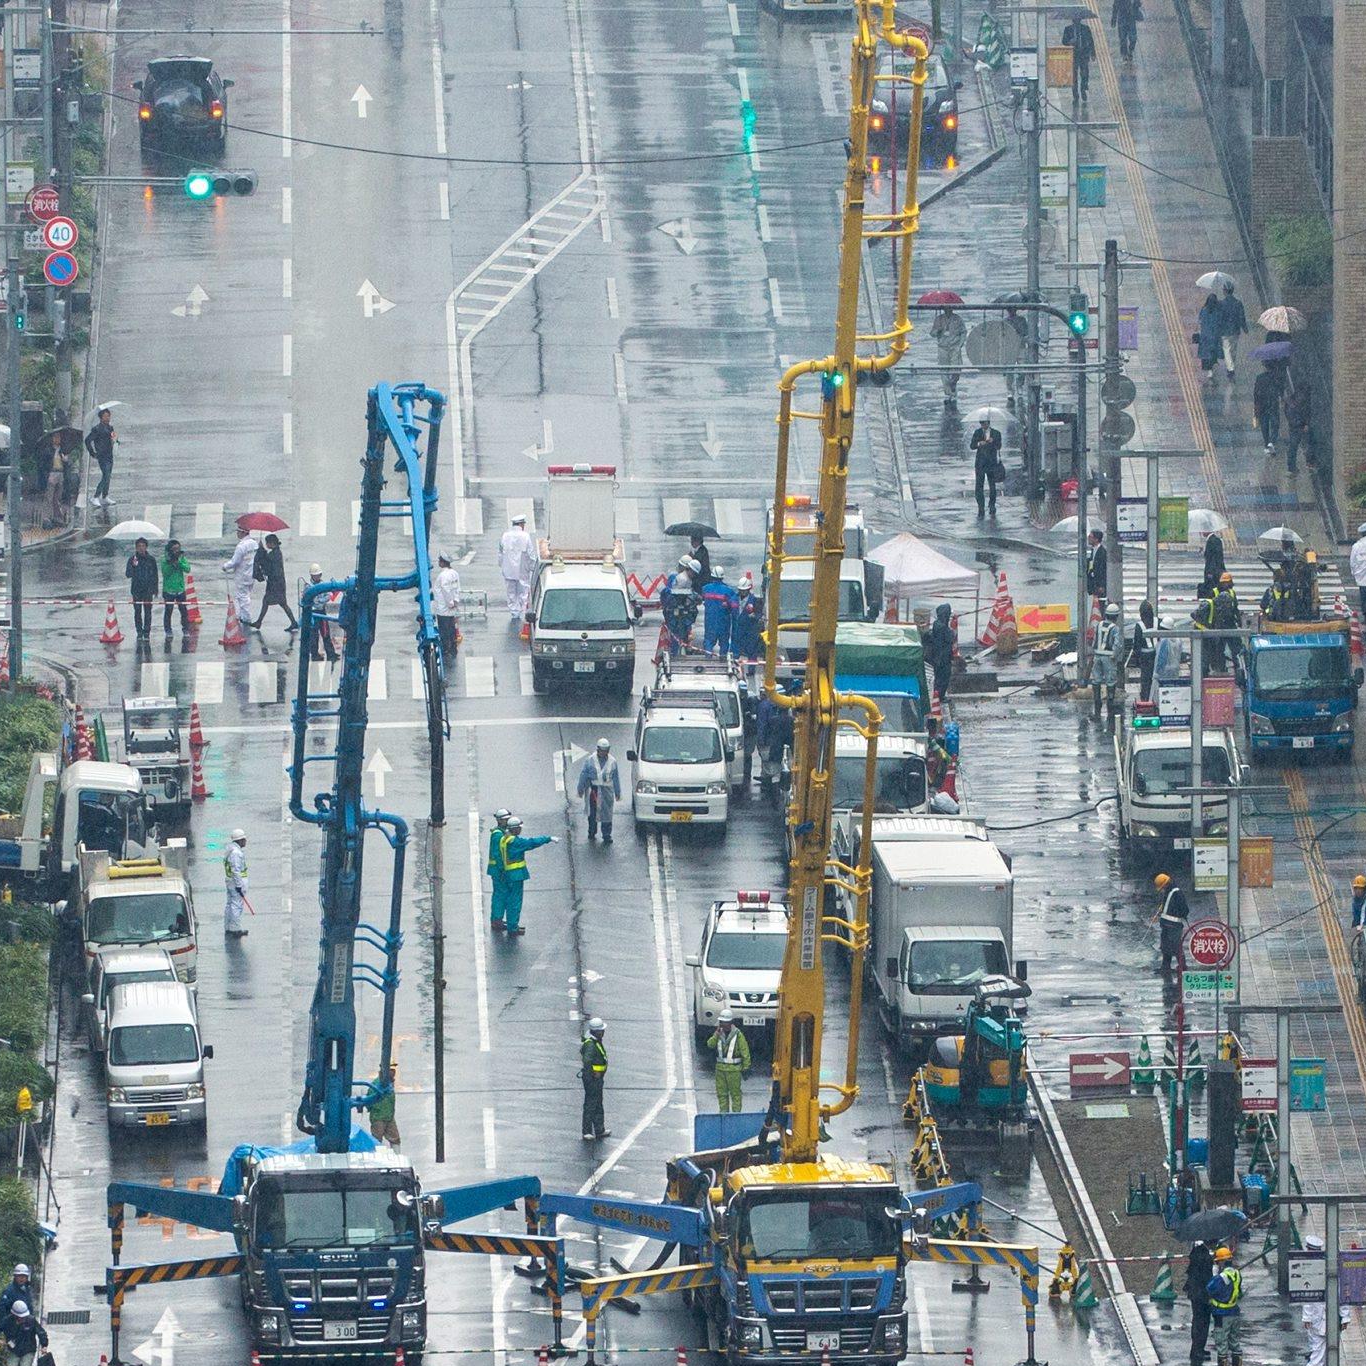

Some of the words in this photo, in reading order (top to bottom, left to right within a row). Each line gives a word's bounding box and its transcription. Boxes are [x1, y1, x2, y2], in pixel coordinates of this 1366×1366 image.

[52, 227, 70, 241] 40
[1193, 938, 1226, 954] 消火栓
[319, 1254, 358, 1263] ISUZU
